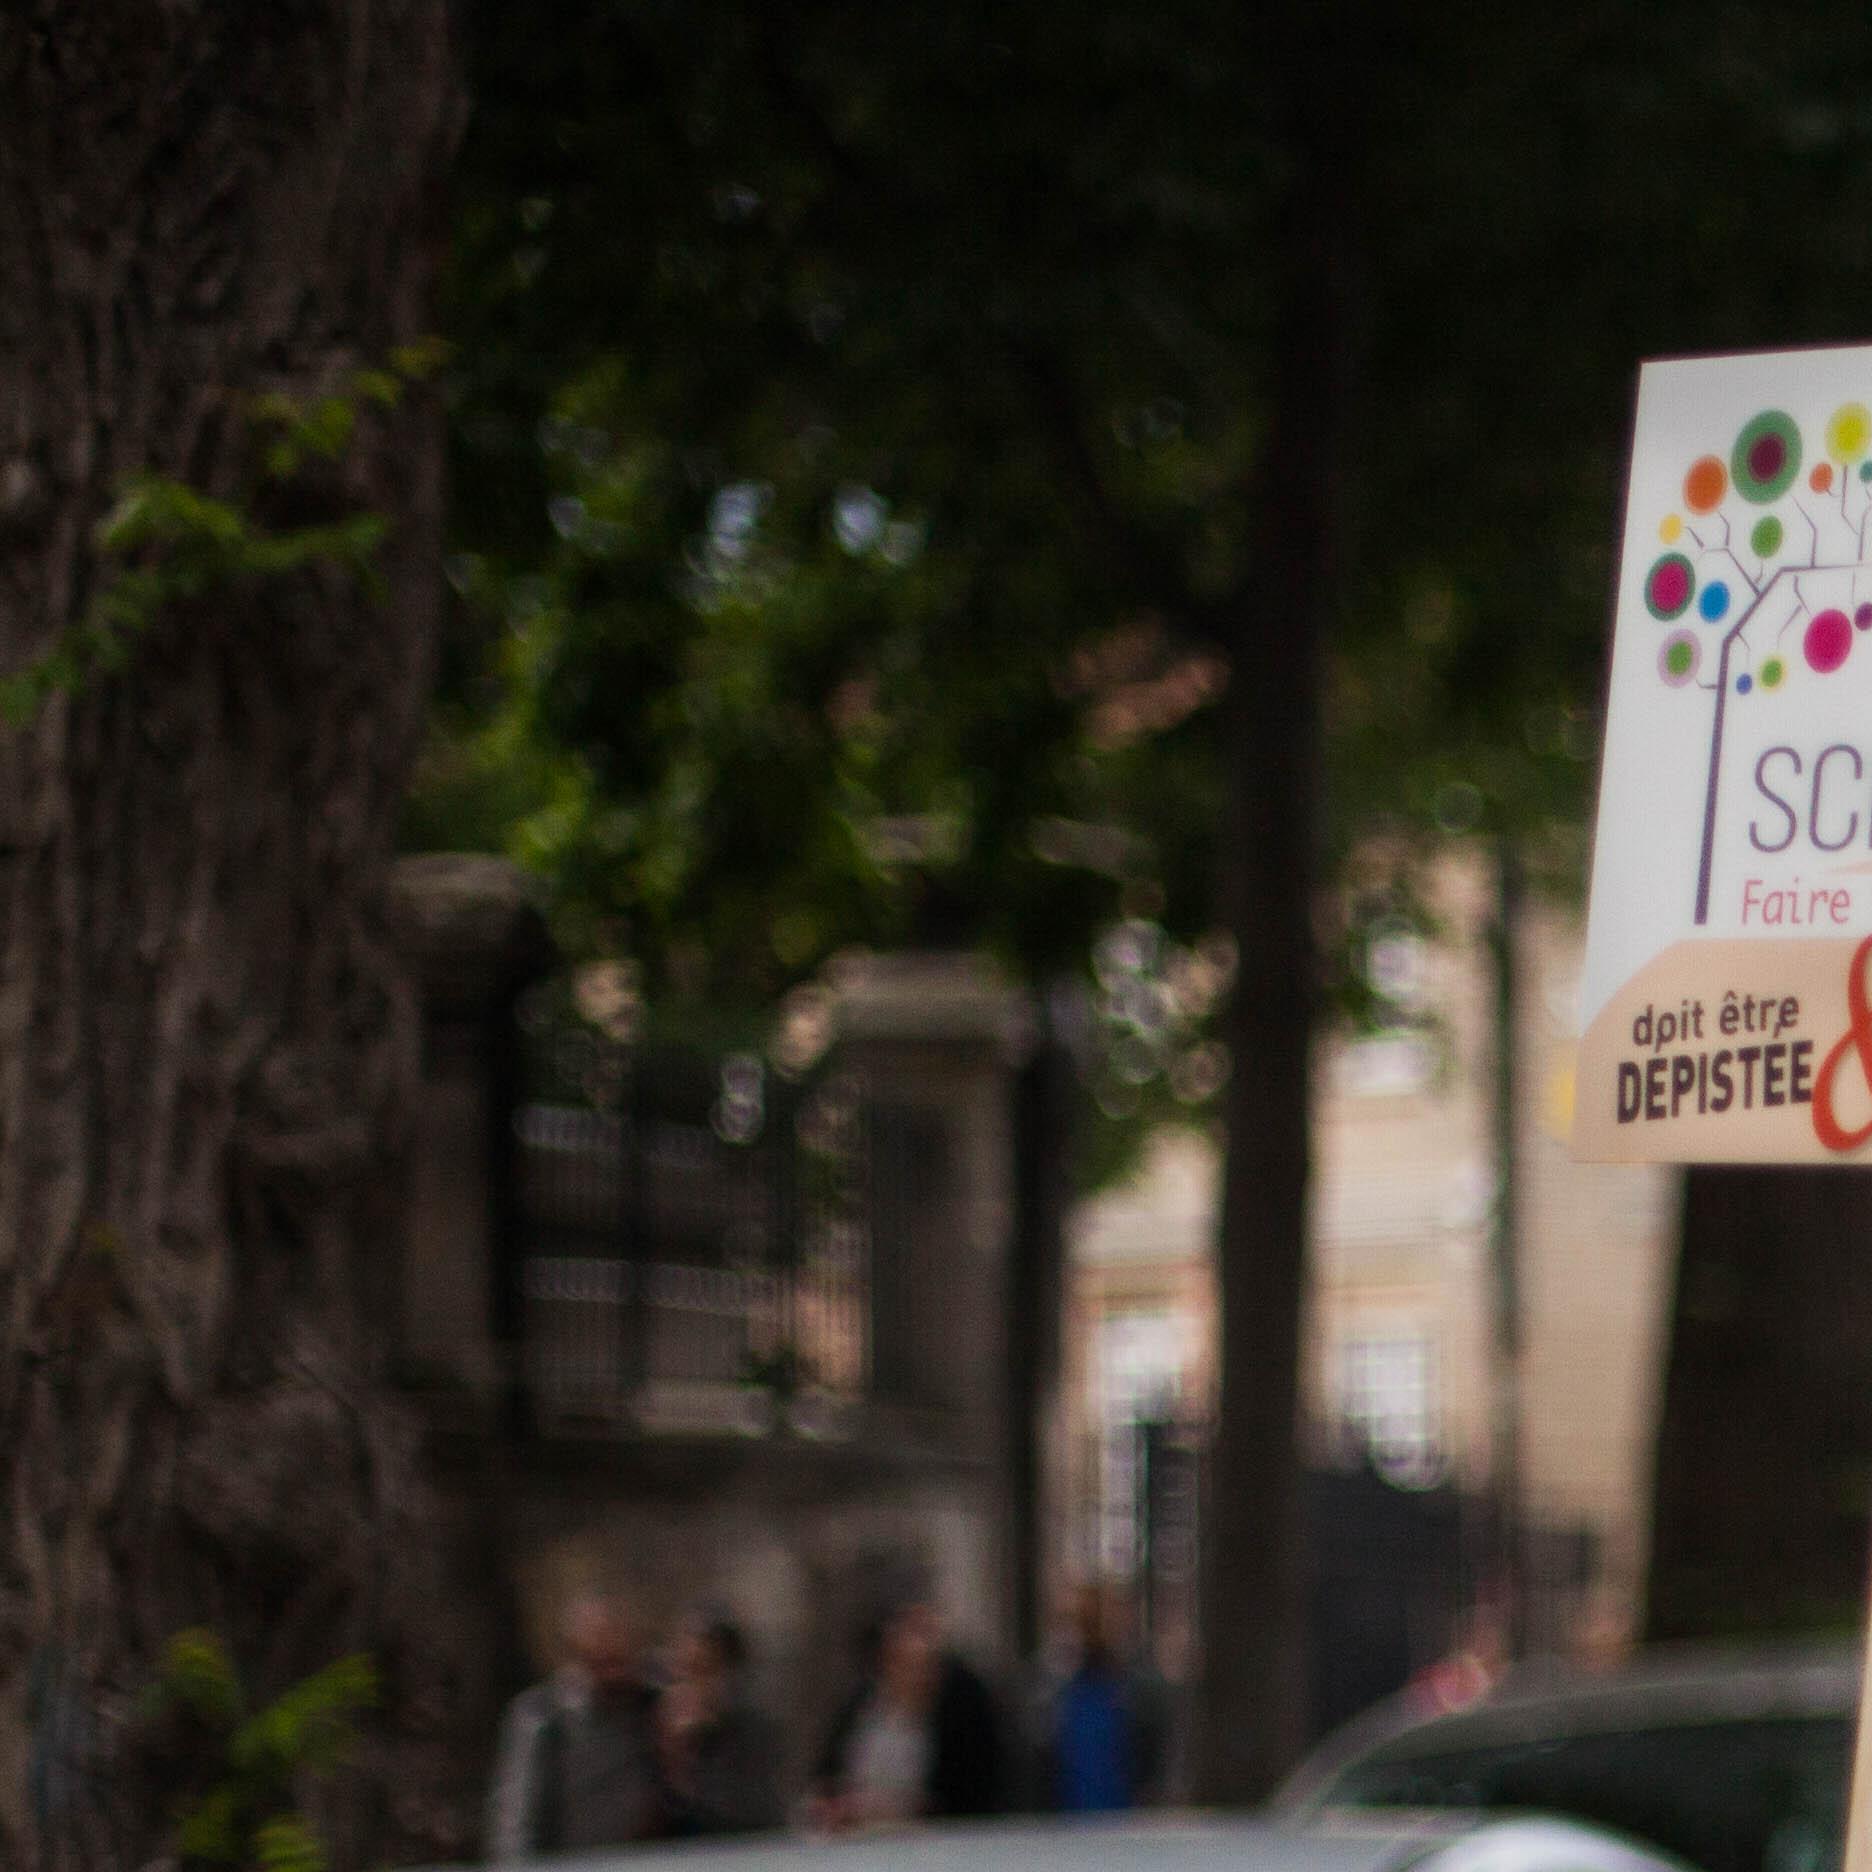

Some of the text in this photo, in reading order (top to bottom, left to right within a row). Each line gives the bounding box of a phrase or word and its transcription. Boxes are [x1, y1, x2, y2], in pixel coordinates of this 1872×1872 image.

[1741, 877, 1851, 925] Faire
[1632, 990, 1800, 1047] doit être
